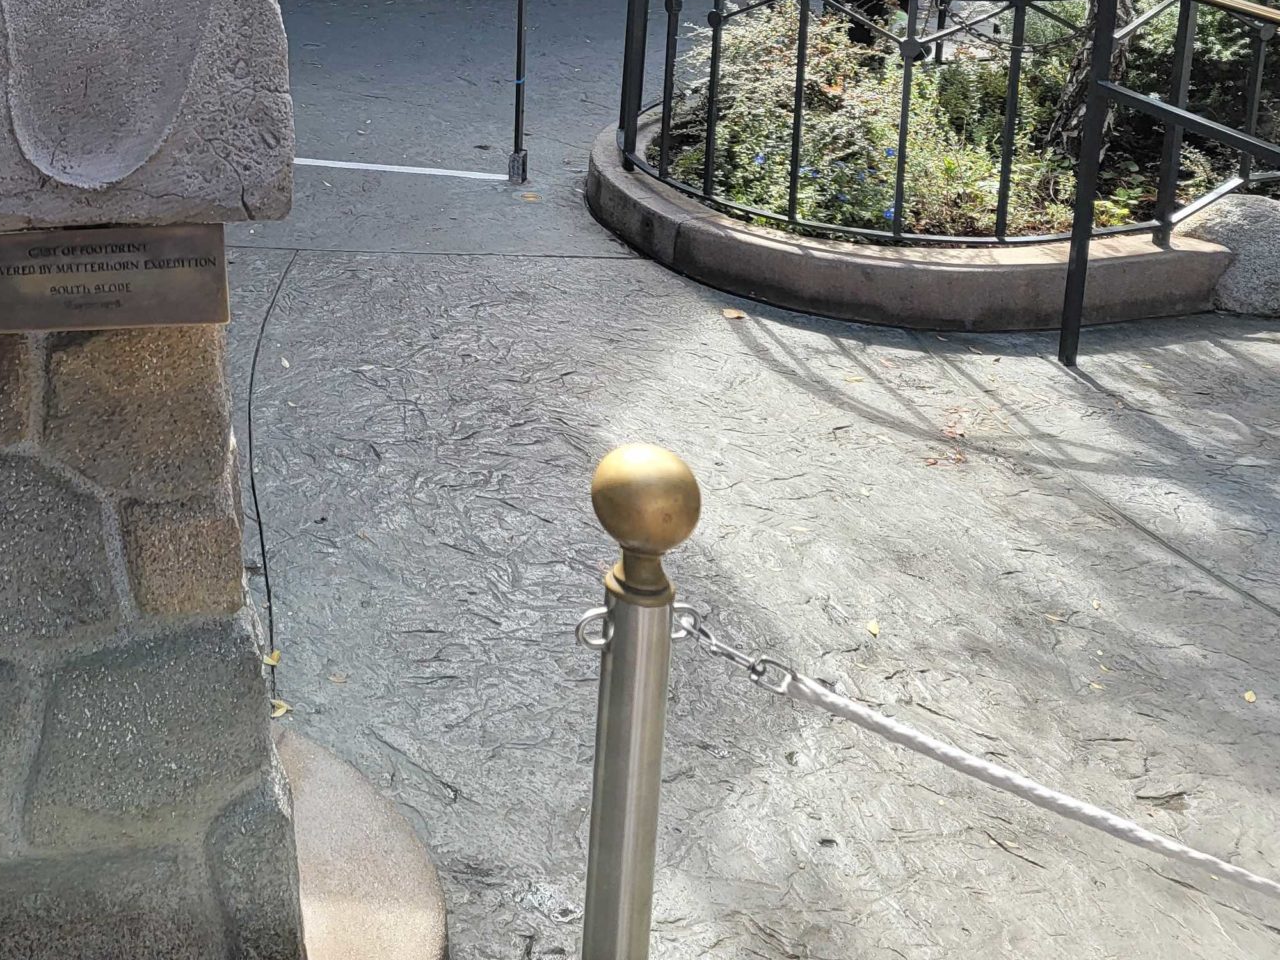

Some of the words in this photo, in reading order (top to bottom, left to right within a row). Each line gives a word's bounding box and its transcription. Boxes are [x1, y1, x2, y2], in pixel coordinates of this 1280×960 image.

[61, 245, 76, 256] OF
[80, 243, 147, 256] FOOTPRINT
[39, 264, 53, 275] BY
[144, 257, 217, 270] EXPEDITION
[94, 282, 132, 295] SLOPE
